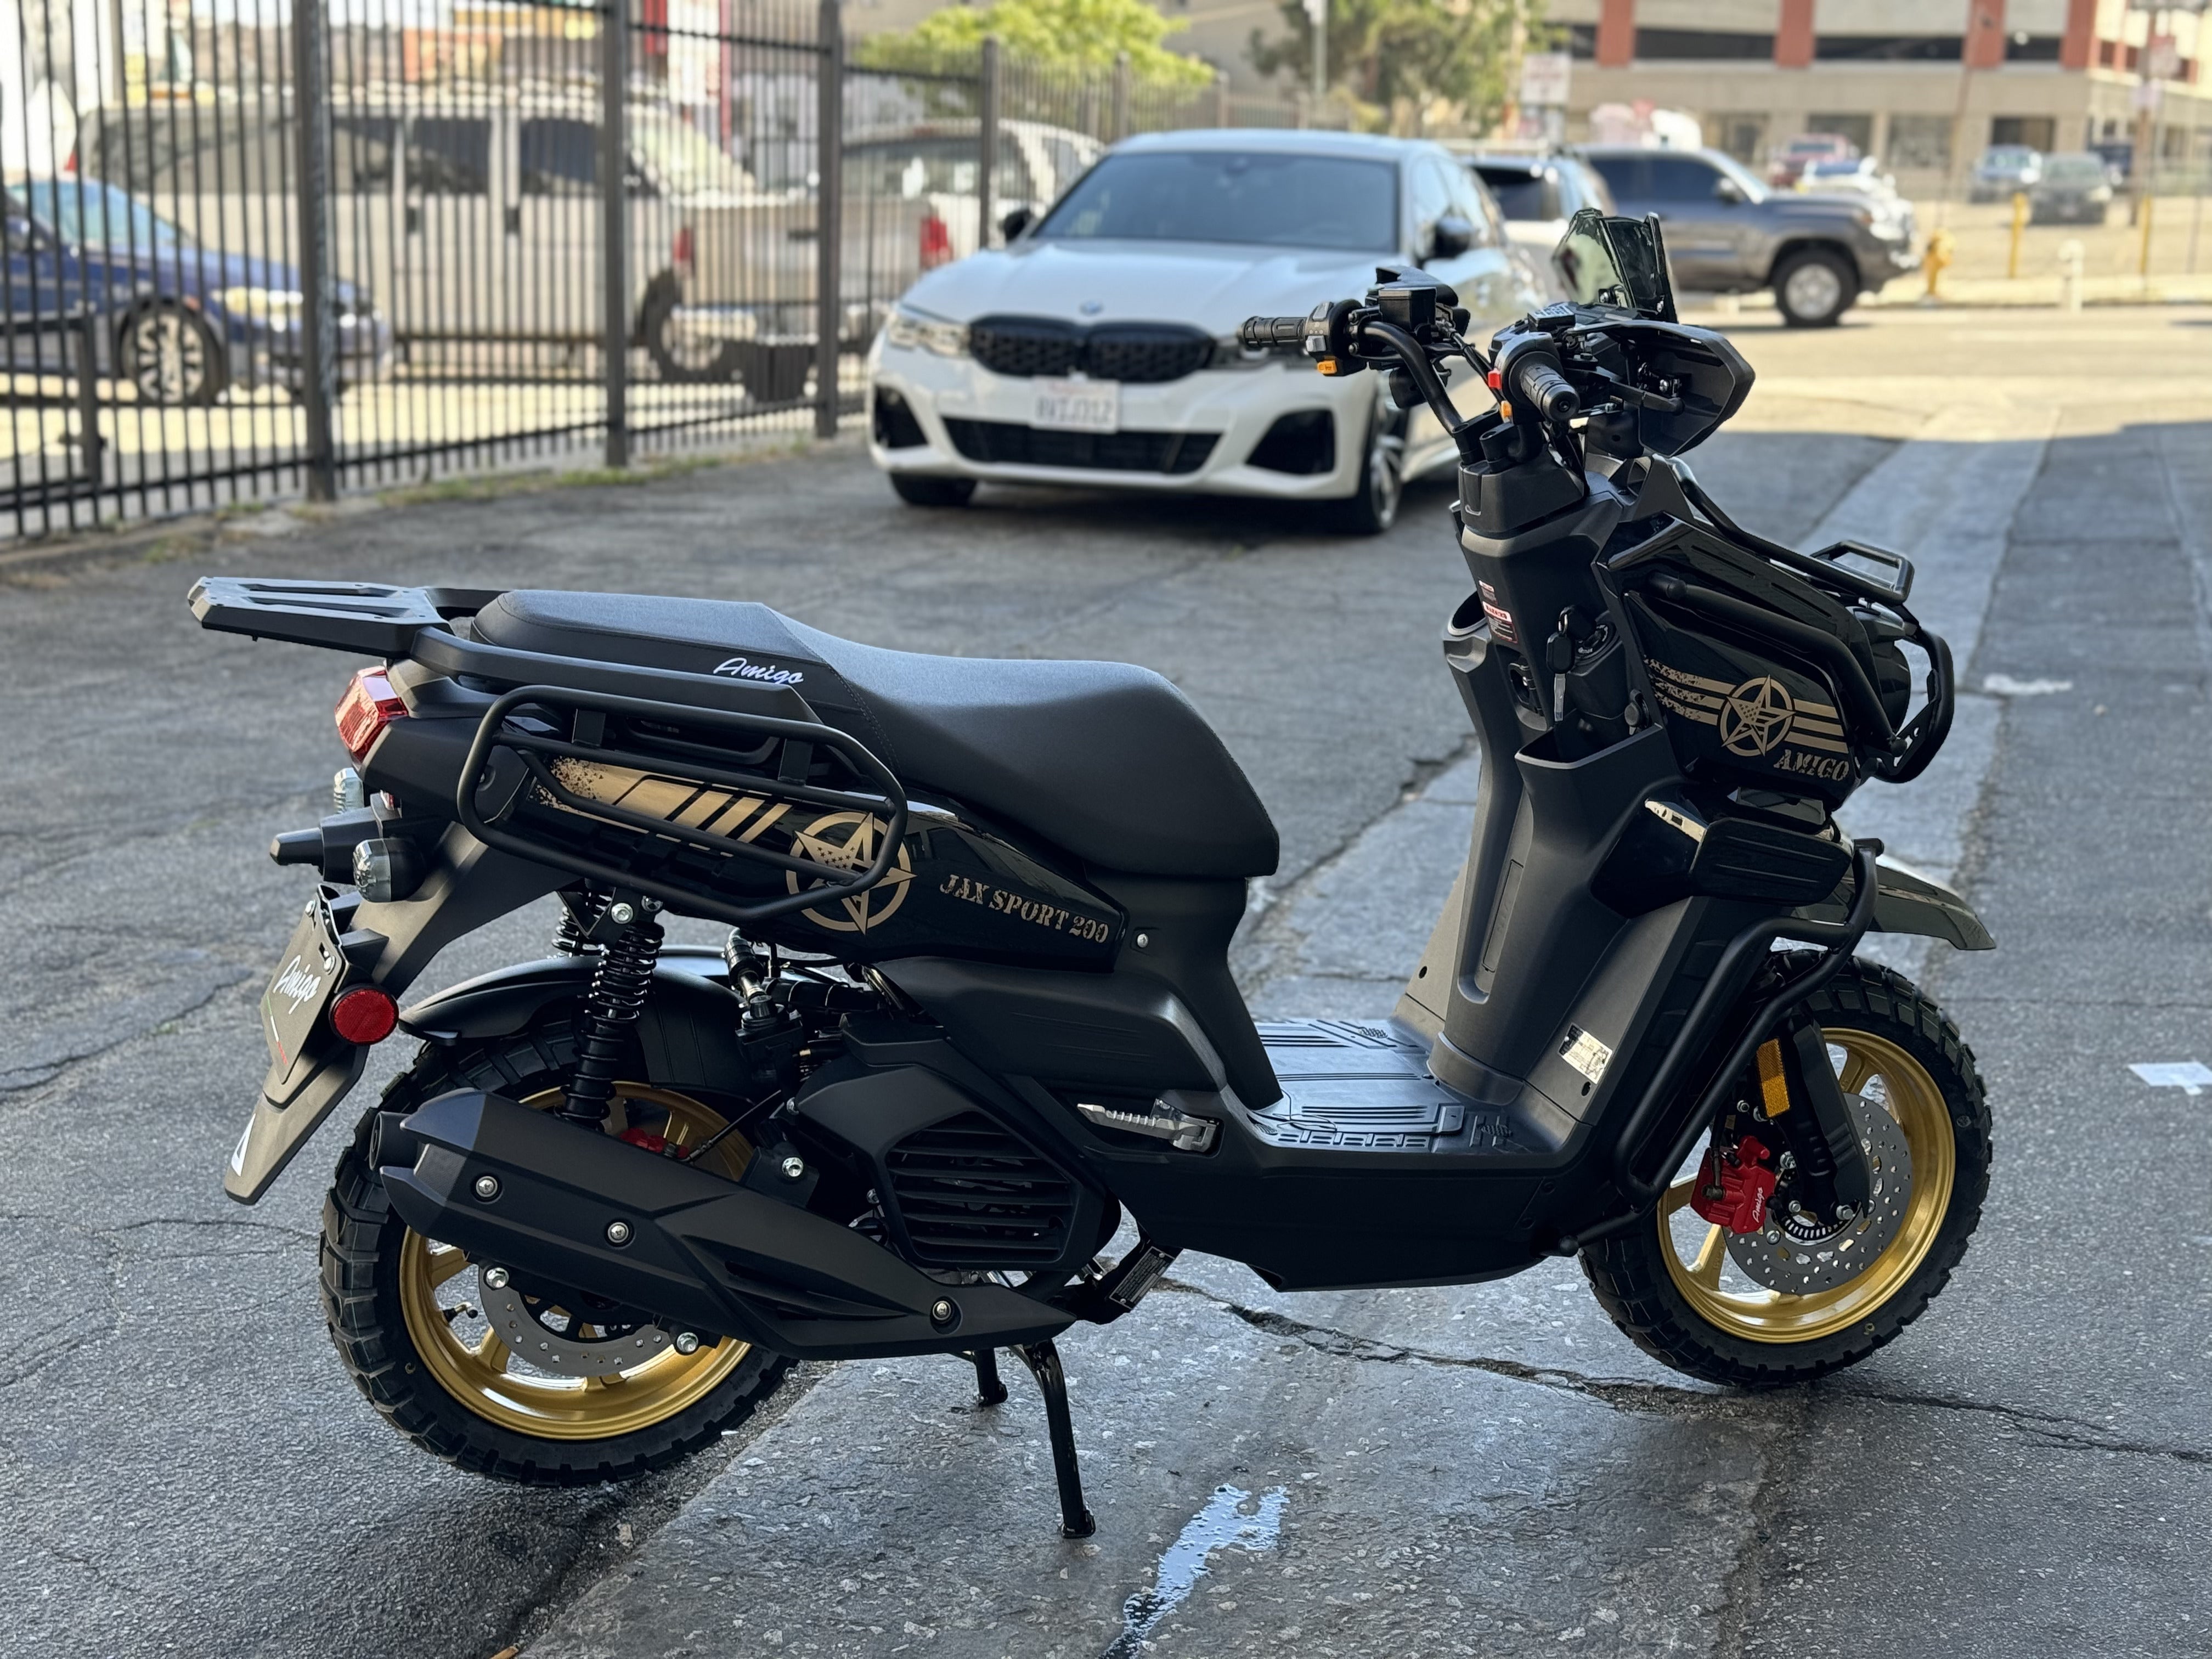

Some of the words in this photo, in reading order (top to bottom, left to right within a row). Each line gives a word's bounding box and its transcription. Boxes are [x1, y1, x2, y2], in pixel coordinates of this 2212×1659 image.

[713, 657, 804, 685] Amigo
[1773, 749, 1849, 781] AMIGO
[940, 874, 990, 905] JAX
[988, 889, 1069, 930] SPORT
[1069, 915, 1109, 943] 200
[273, 955, 321, 1015] Amigo
[1752, 1187, 1765, 1223] Amigo
